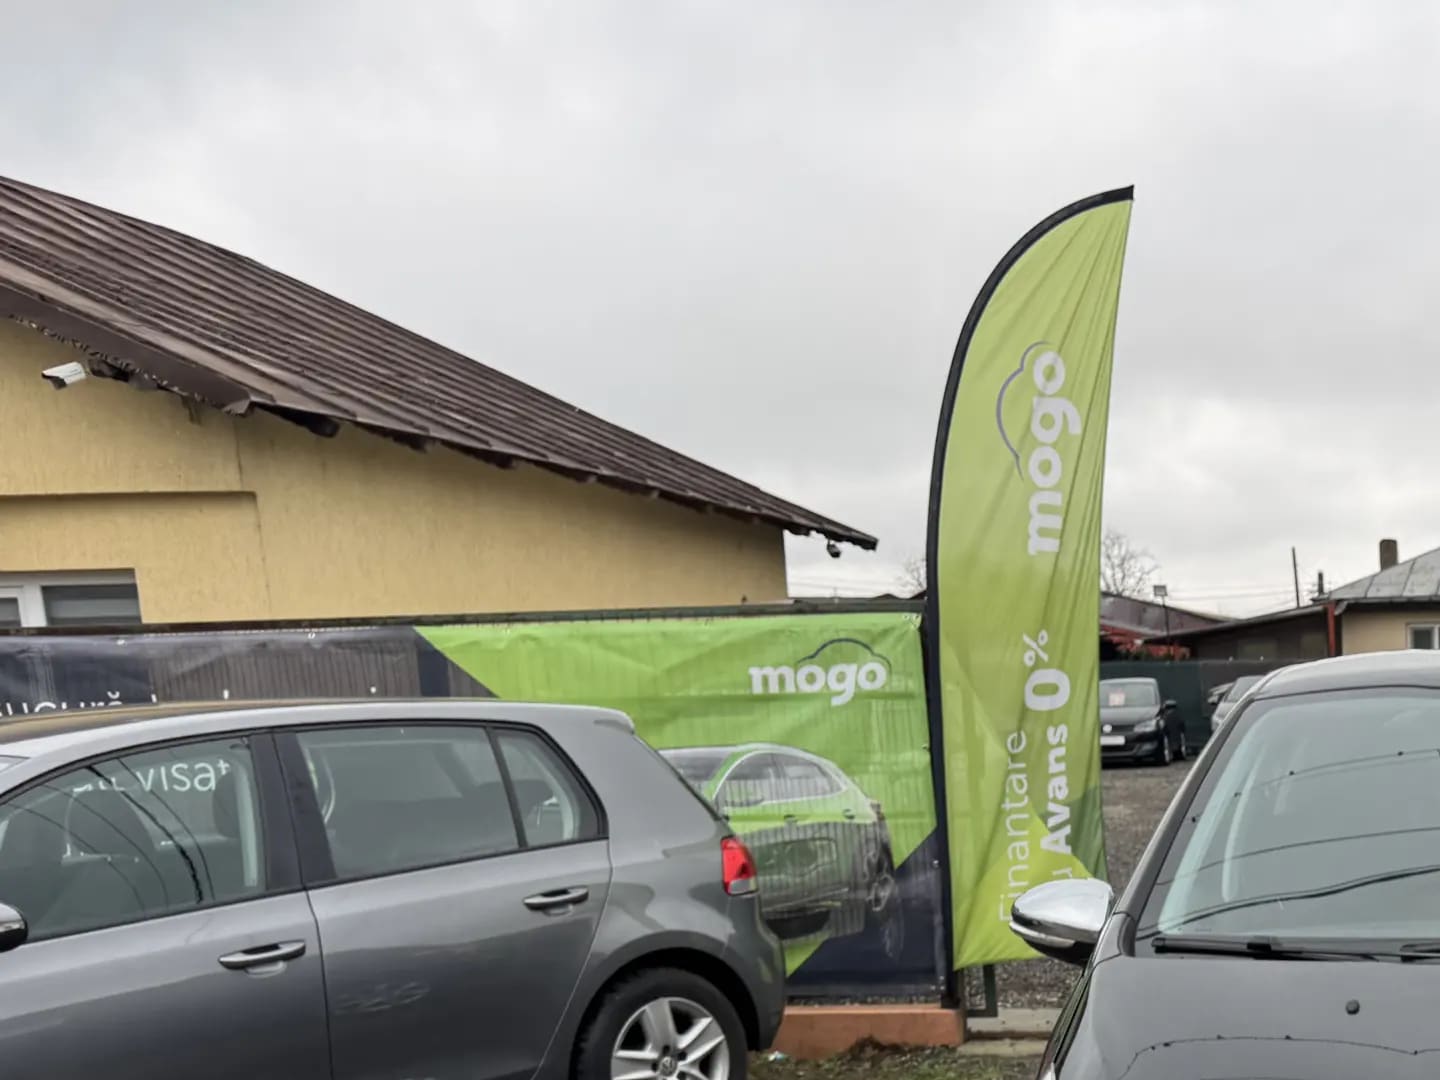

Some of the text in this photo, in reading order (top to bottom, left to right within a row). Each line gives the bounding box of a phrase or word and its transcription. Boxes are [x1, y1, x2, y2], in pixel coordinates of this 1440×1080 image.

[1028, 351, 1082, 556] mogo
[749, 662, 887, 706] mogo
[1023, 630, 1071, 711] 0%
[1040, 723, 1072, 855] Avans
